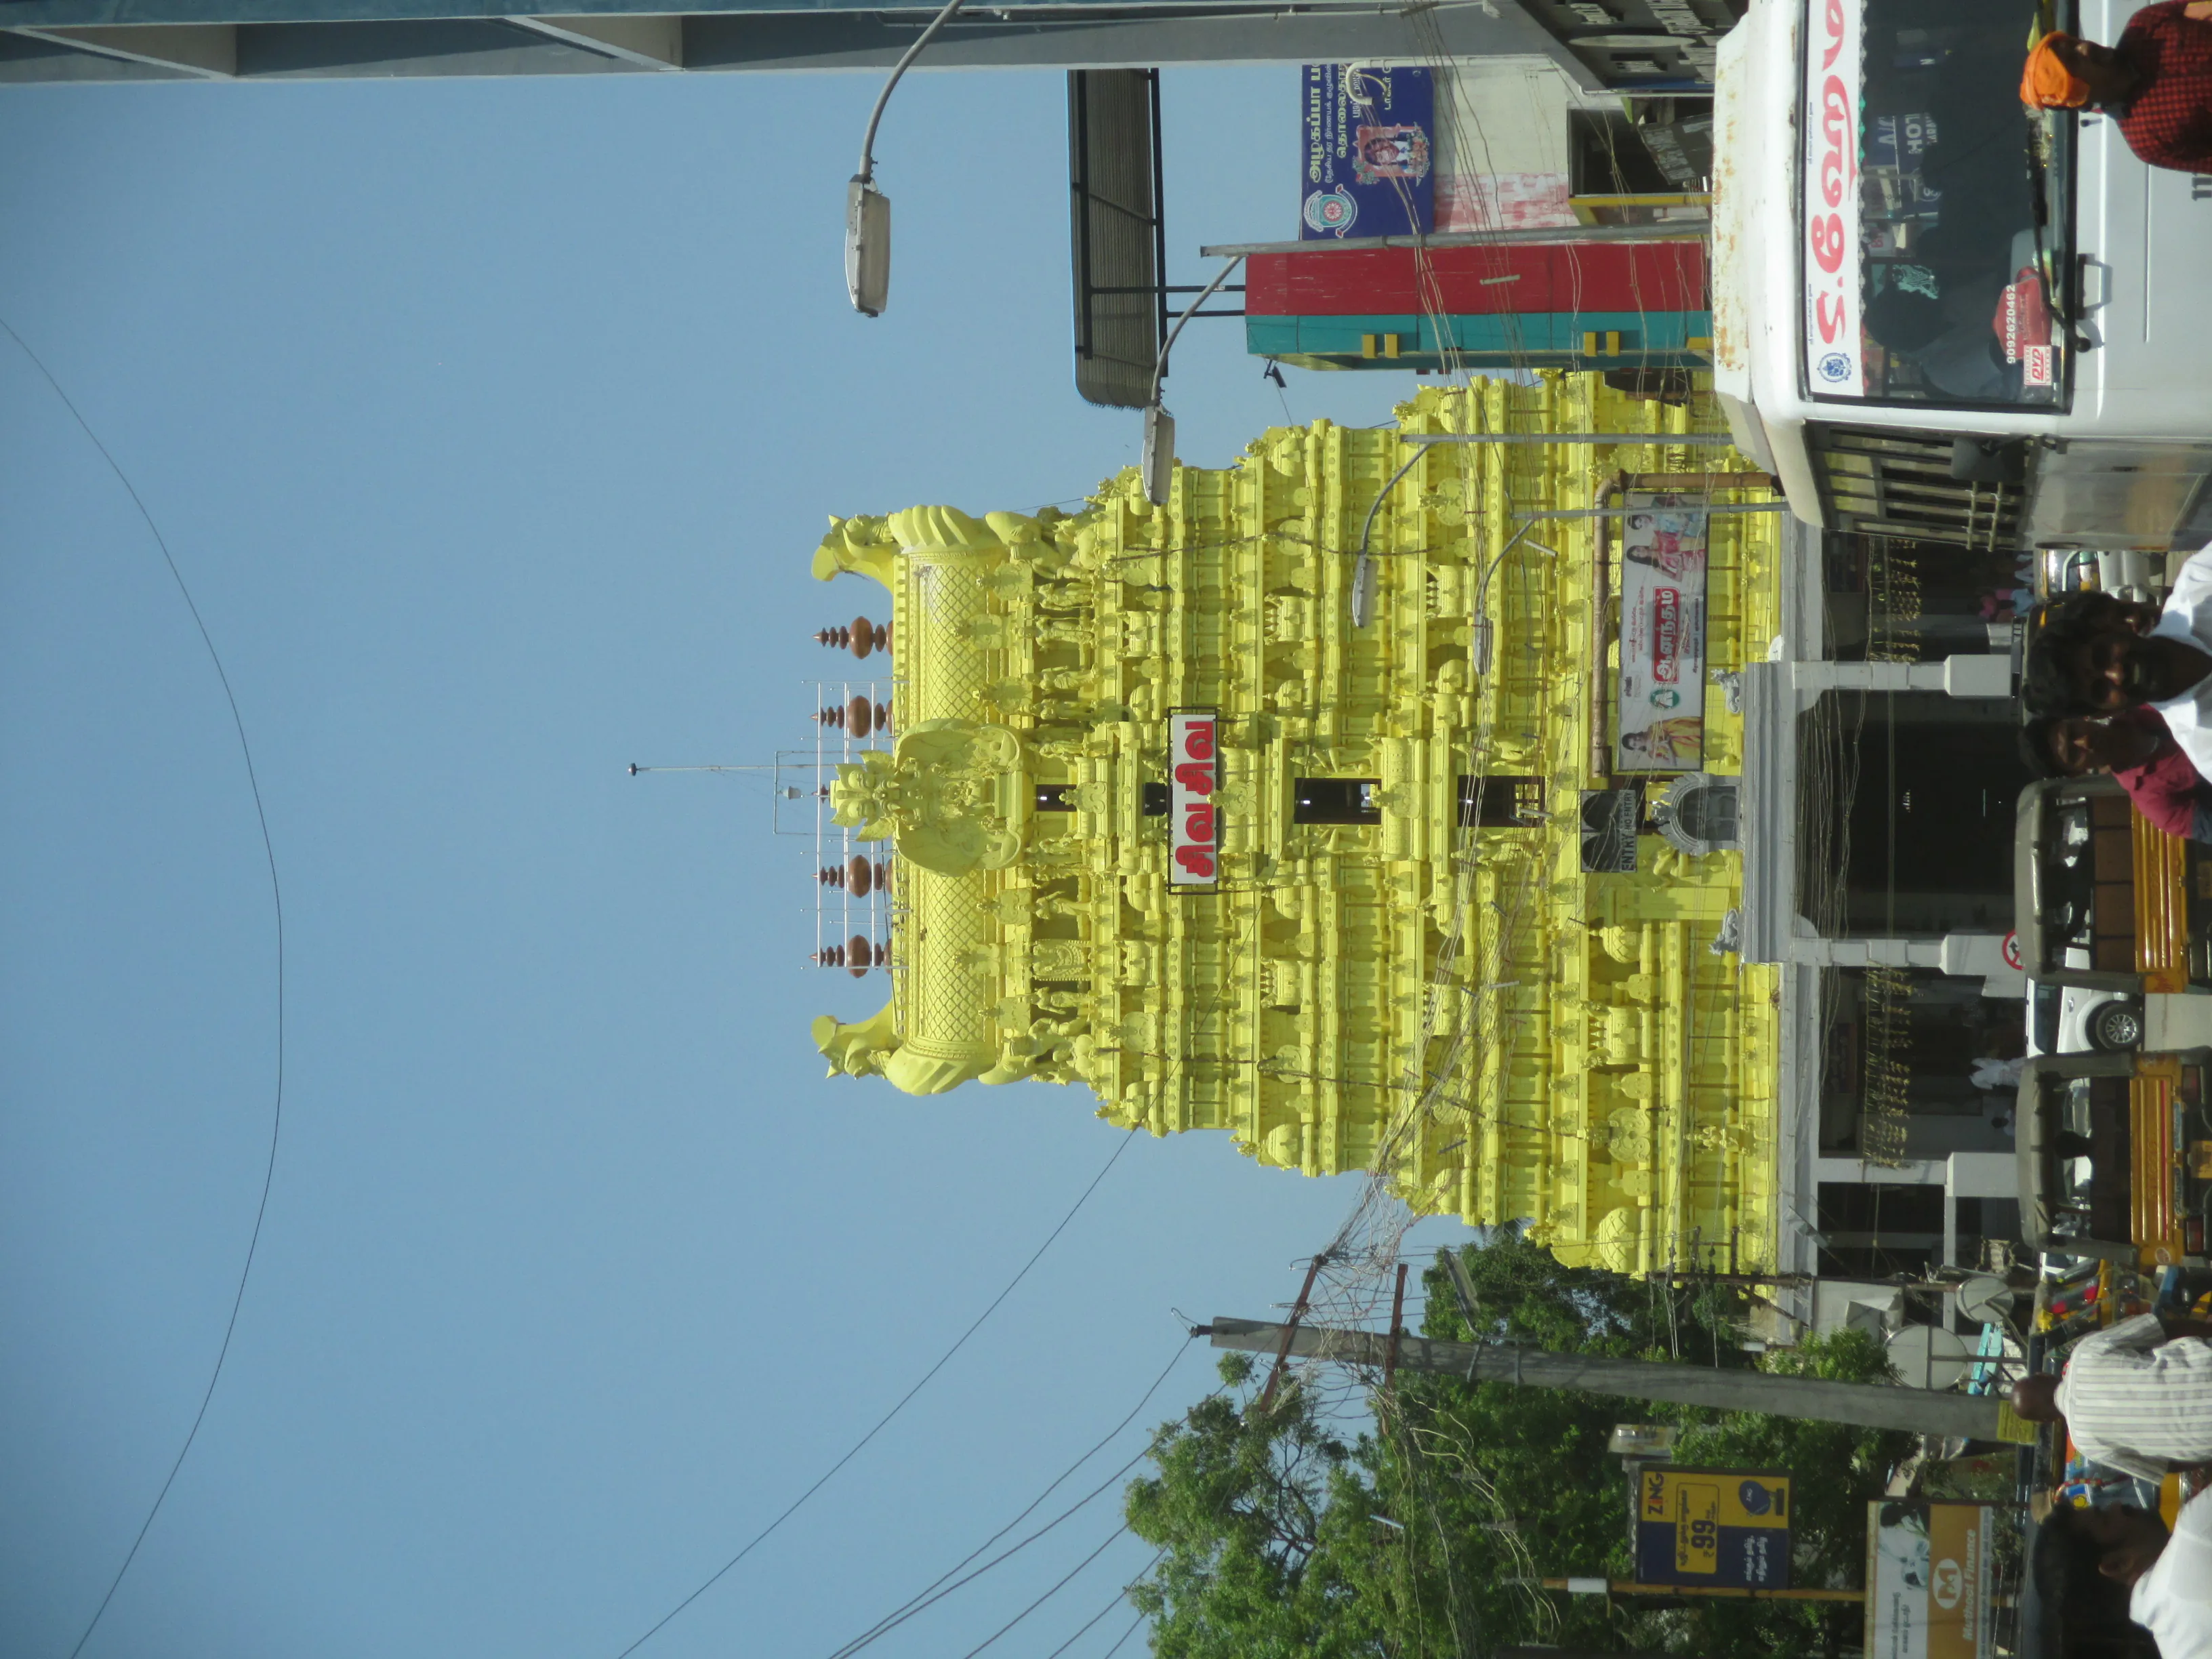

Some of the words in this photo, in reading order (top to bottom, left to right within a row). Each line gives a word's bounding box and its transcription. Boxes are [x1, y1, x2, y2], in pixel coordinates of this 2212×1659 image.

[1310, 63, 1322, 81] ப
[1306, 86, 1325, 183] அழகப்பா
[2005, 284, 2017, 364] 9092620462
[1655, 590, 1677, 680] ஆனந்தம்
[1174, 720, 1214, 796] சிவ
[1623, 792, 1633, 817] ENTRY
[1174, 803, 1214, 878] சிவ
[1621, 834, 1635, 871] ENTRY
[1647, 1473, 1664, 1515] ZING
[1963, 1528, 1977, 1580] Finance
[1963, 1583, 1975, 1641] Muthoot
